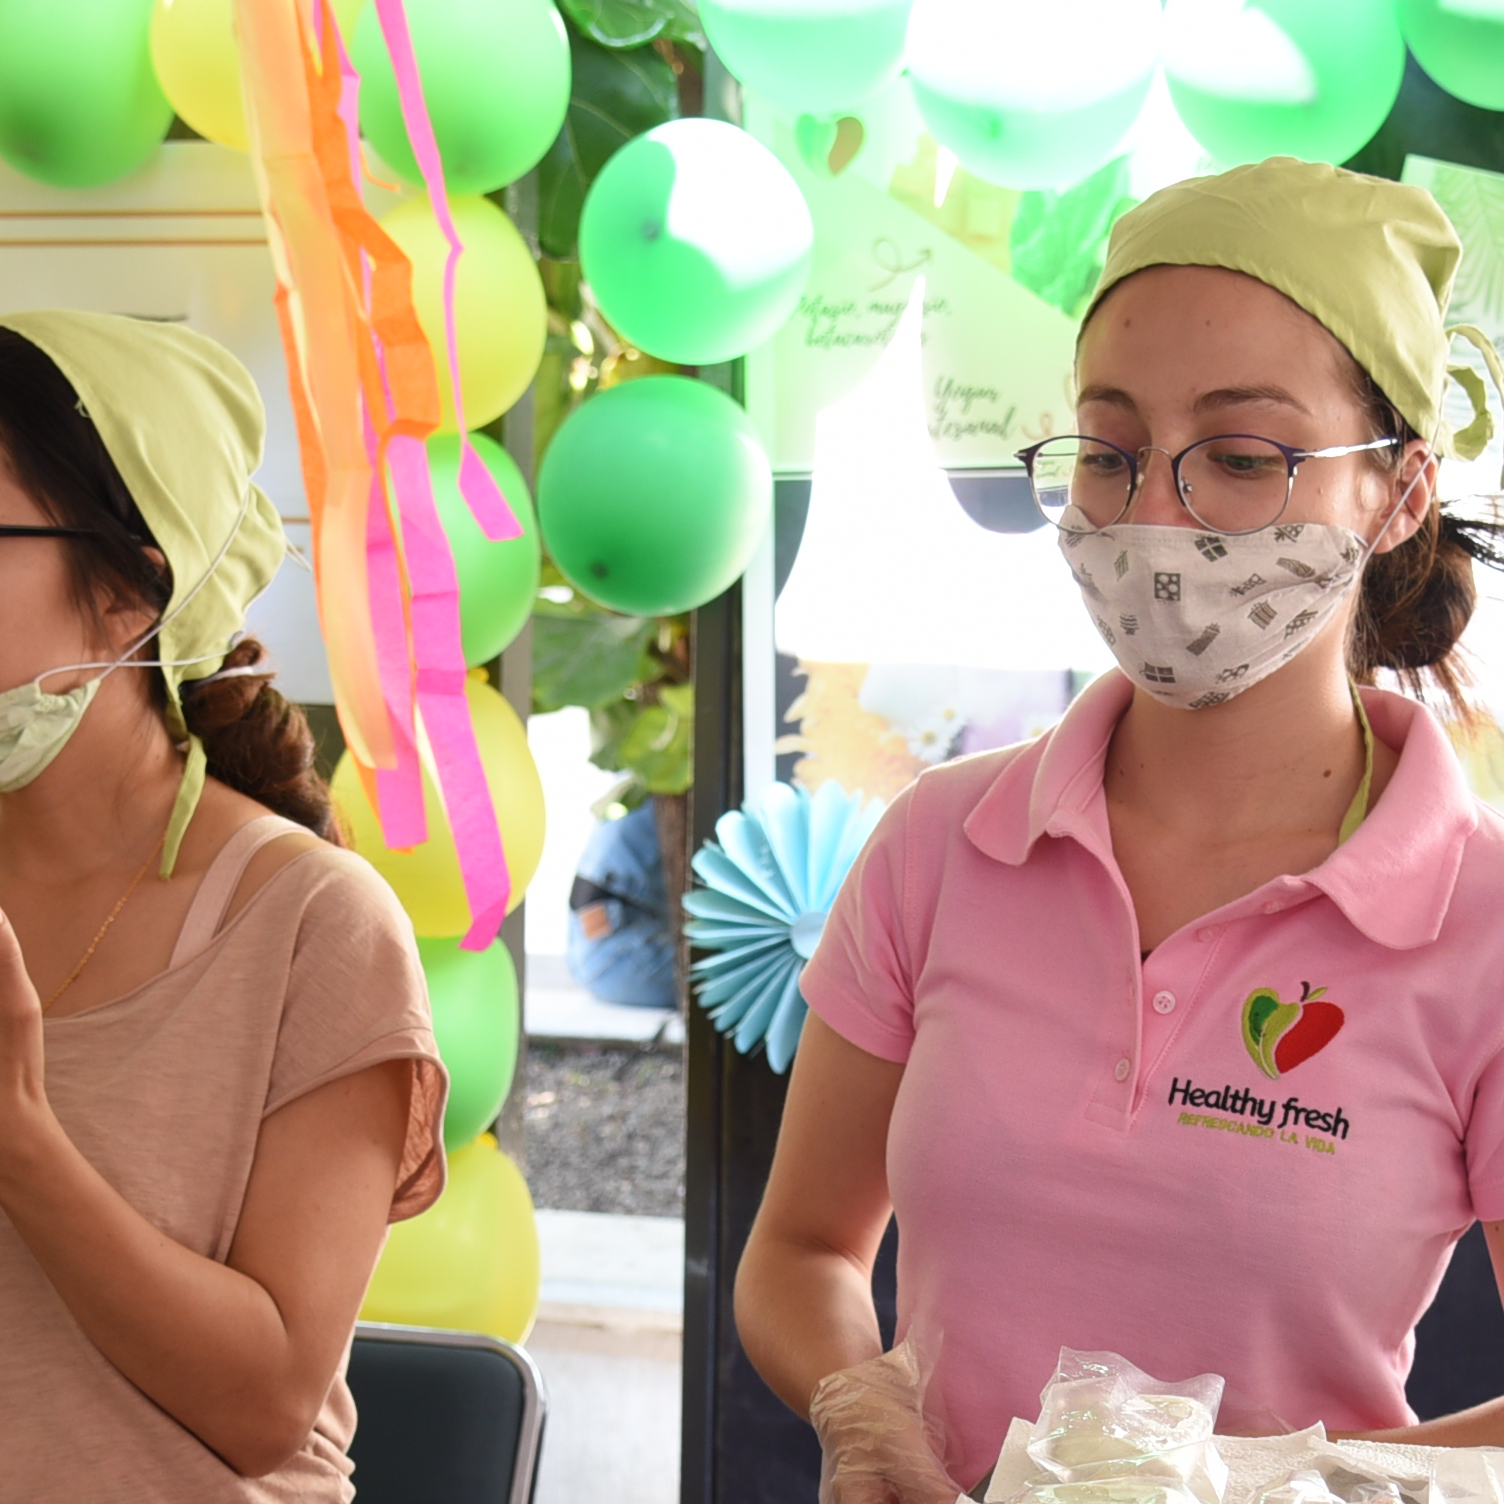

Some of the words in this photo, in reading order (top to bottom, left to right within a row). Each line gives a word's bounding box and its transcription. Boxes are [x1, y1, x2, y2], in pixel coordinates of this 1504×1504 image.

[1168, 1077, 1276, 1125] Healthy
[1277, 1097, 1350, 1140] fresh
[1177, 1112, 1275, 1138] REFRESCANDO
[1280, 1129, 1299, 1144] LA
[1305, 1135, 1336, 1155] VIDA
